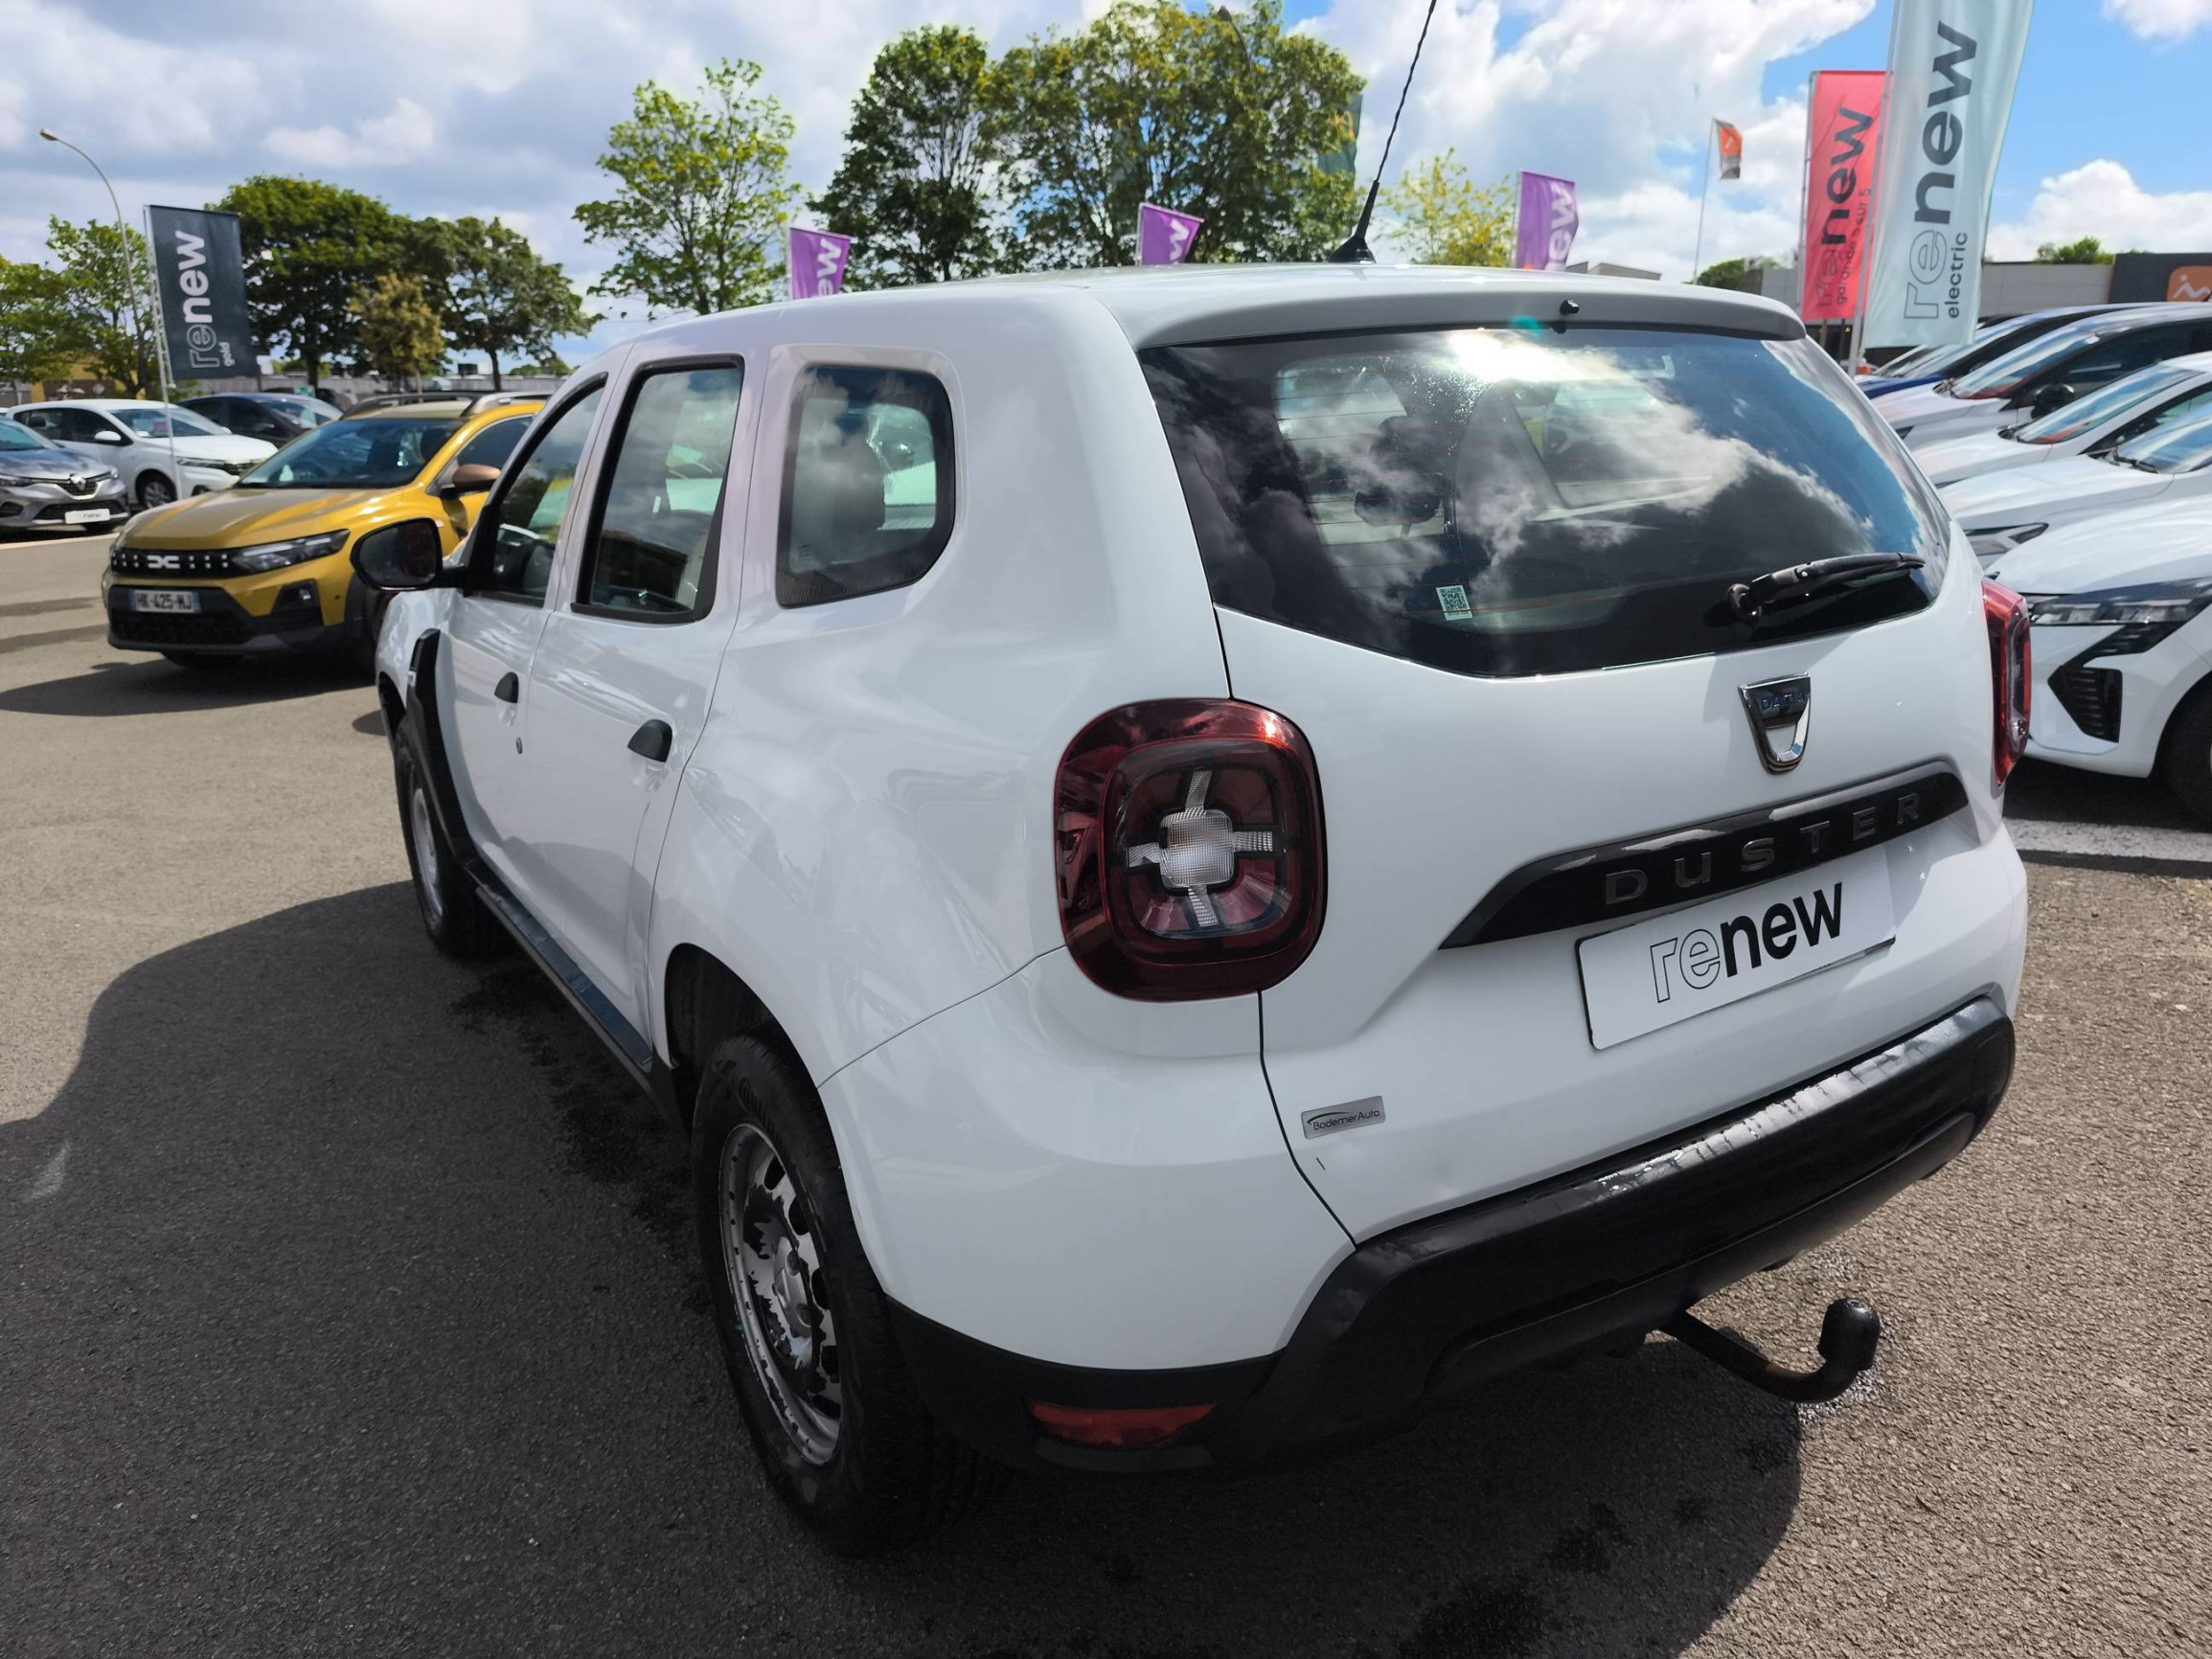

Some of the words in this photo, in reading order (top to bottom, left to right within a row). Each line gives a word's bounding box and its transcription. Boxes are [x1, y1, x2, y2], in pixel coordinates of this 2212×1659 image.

[1904, 20, 1978, 319] renew
[174, 230, 220, 368] renew
[1945, 232, 1968, 319] electric
[1605, 793, 1919, 905] DUSTER
[1650, 882, 1842, 1004] renew
